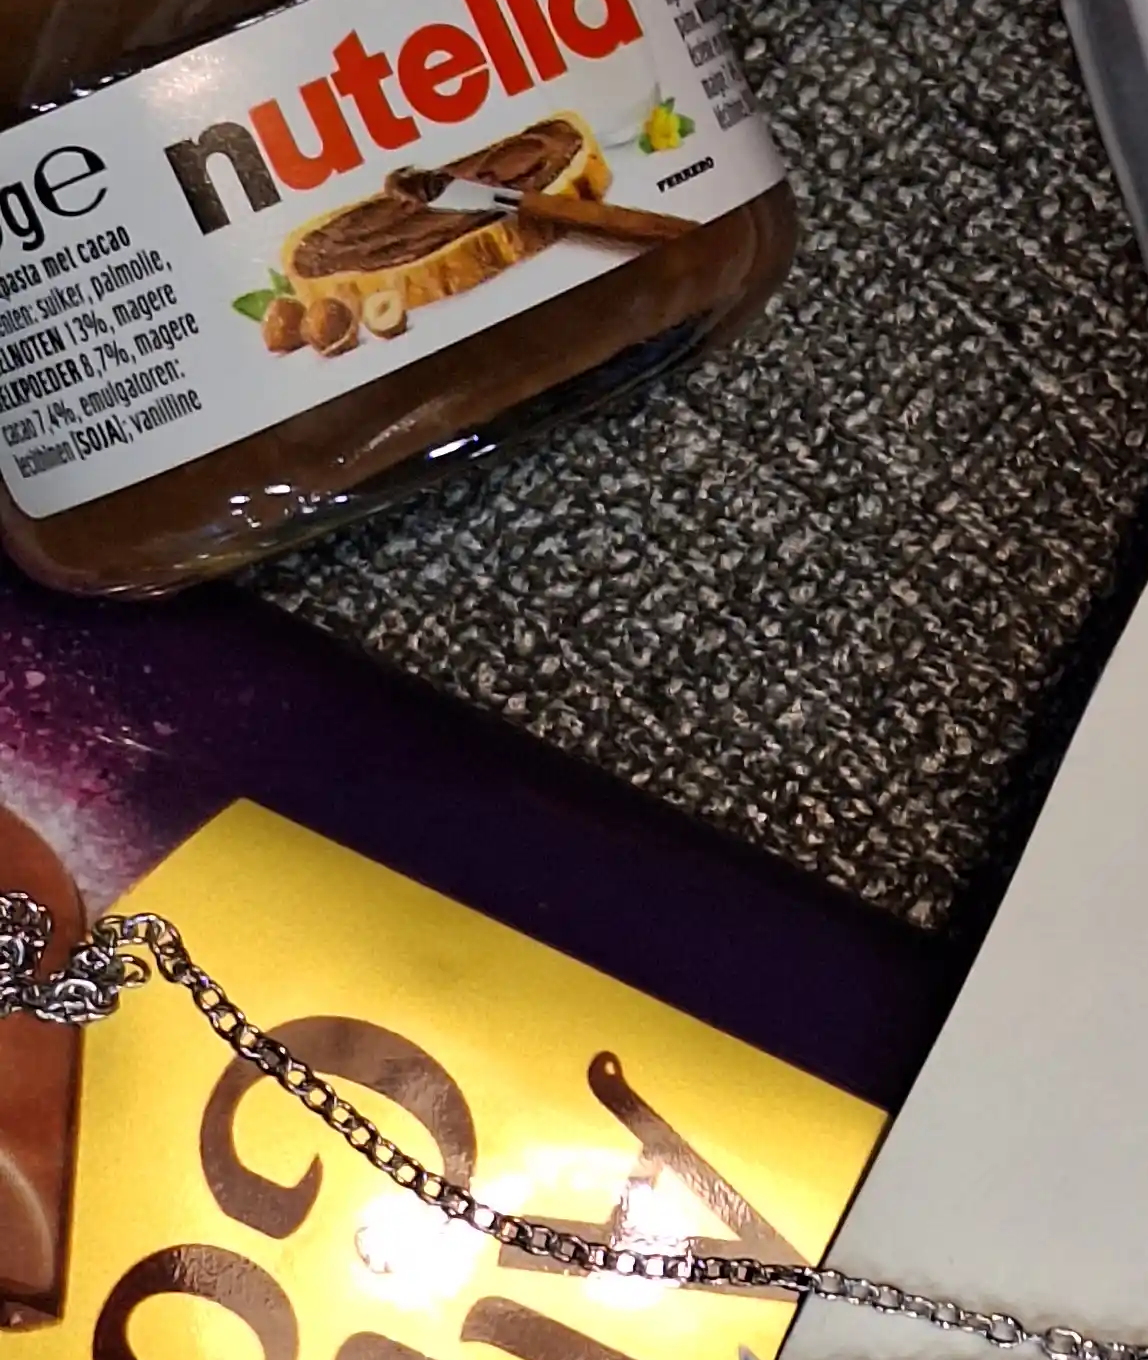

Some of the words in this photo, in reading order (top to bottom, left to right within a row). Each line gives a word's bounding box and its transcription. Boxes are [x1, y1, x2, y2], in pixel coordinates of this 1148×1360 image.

[656, 156, 714, 193] FERRERO
[77, 225, 131, 264] cacao
[112, 283, 178, 327] magere
[0, 358, 83, 413] ELKPOEDER
[133, 313, 200, 357] magere
[79, 358, 186, 417] emulgatoren:
[129, 388, 203, 434] vanilline
